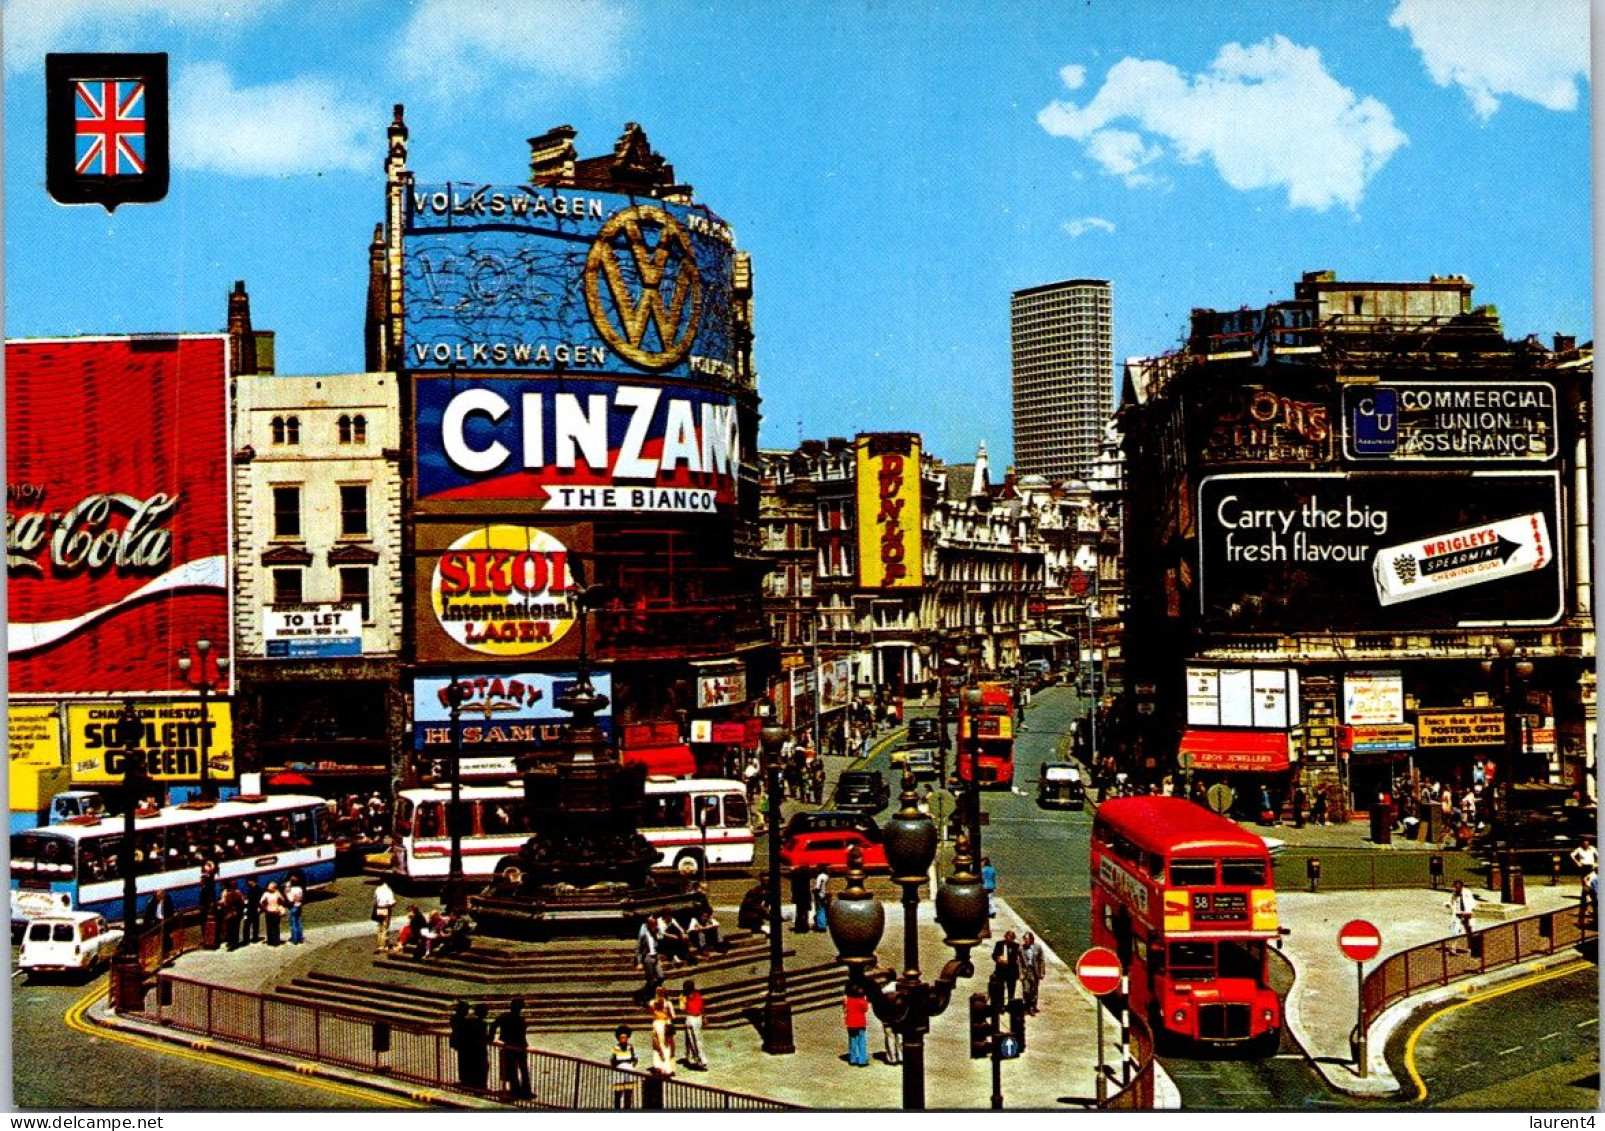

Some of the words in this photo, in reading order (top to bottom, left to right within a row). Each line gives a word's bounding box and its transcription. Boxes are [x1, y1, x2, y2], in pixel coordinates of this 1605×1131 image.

[413, 192, 604, 217] VOLKSWAGEN
[415, 342, 606, 366] VOLKSWAGEN
[1401, 391, 1551, 408] COMMERCIAL
[1440, 411, 1511, 429] UNION
[1406, 433, 1547, 451] ASSURANCE
[559, 488, 617, 508] THE
[631, 489, 712, 510] BIANCO
[877, 455, 906, 588] DUNLOP
[1217, 495, 1297, 535] Carry
[1302, 494, 1342, 528] the
[1346, 495, 1389, 536] big
[1226, 530, 1288, 562] fresh
[1293, 530, 1370, 562] flavour
[1422, 529, 1497, 557] WRIGLEY'S
[1426, 545, 1500, 572] SPEARMINT
[439, 551, 577, 593] SKOL
[1430, 565, 1475, 582] CHEWING
[1477, 559, 1500, 572] GUM
[283, 614, 304, 627] TO
[313, 612, 342, 626] LET
[441, 599, 573, 621] International
[465, 620, 553, 643] LAGER
[84, 720, 217, 748] SOLENT
[424, 727, 452, 744] H
[1430, 726, 1472, 735] POSTERS
[1474, 724, 1501, 733] GIFTS
[1194, 896, 1209, 909] 38
